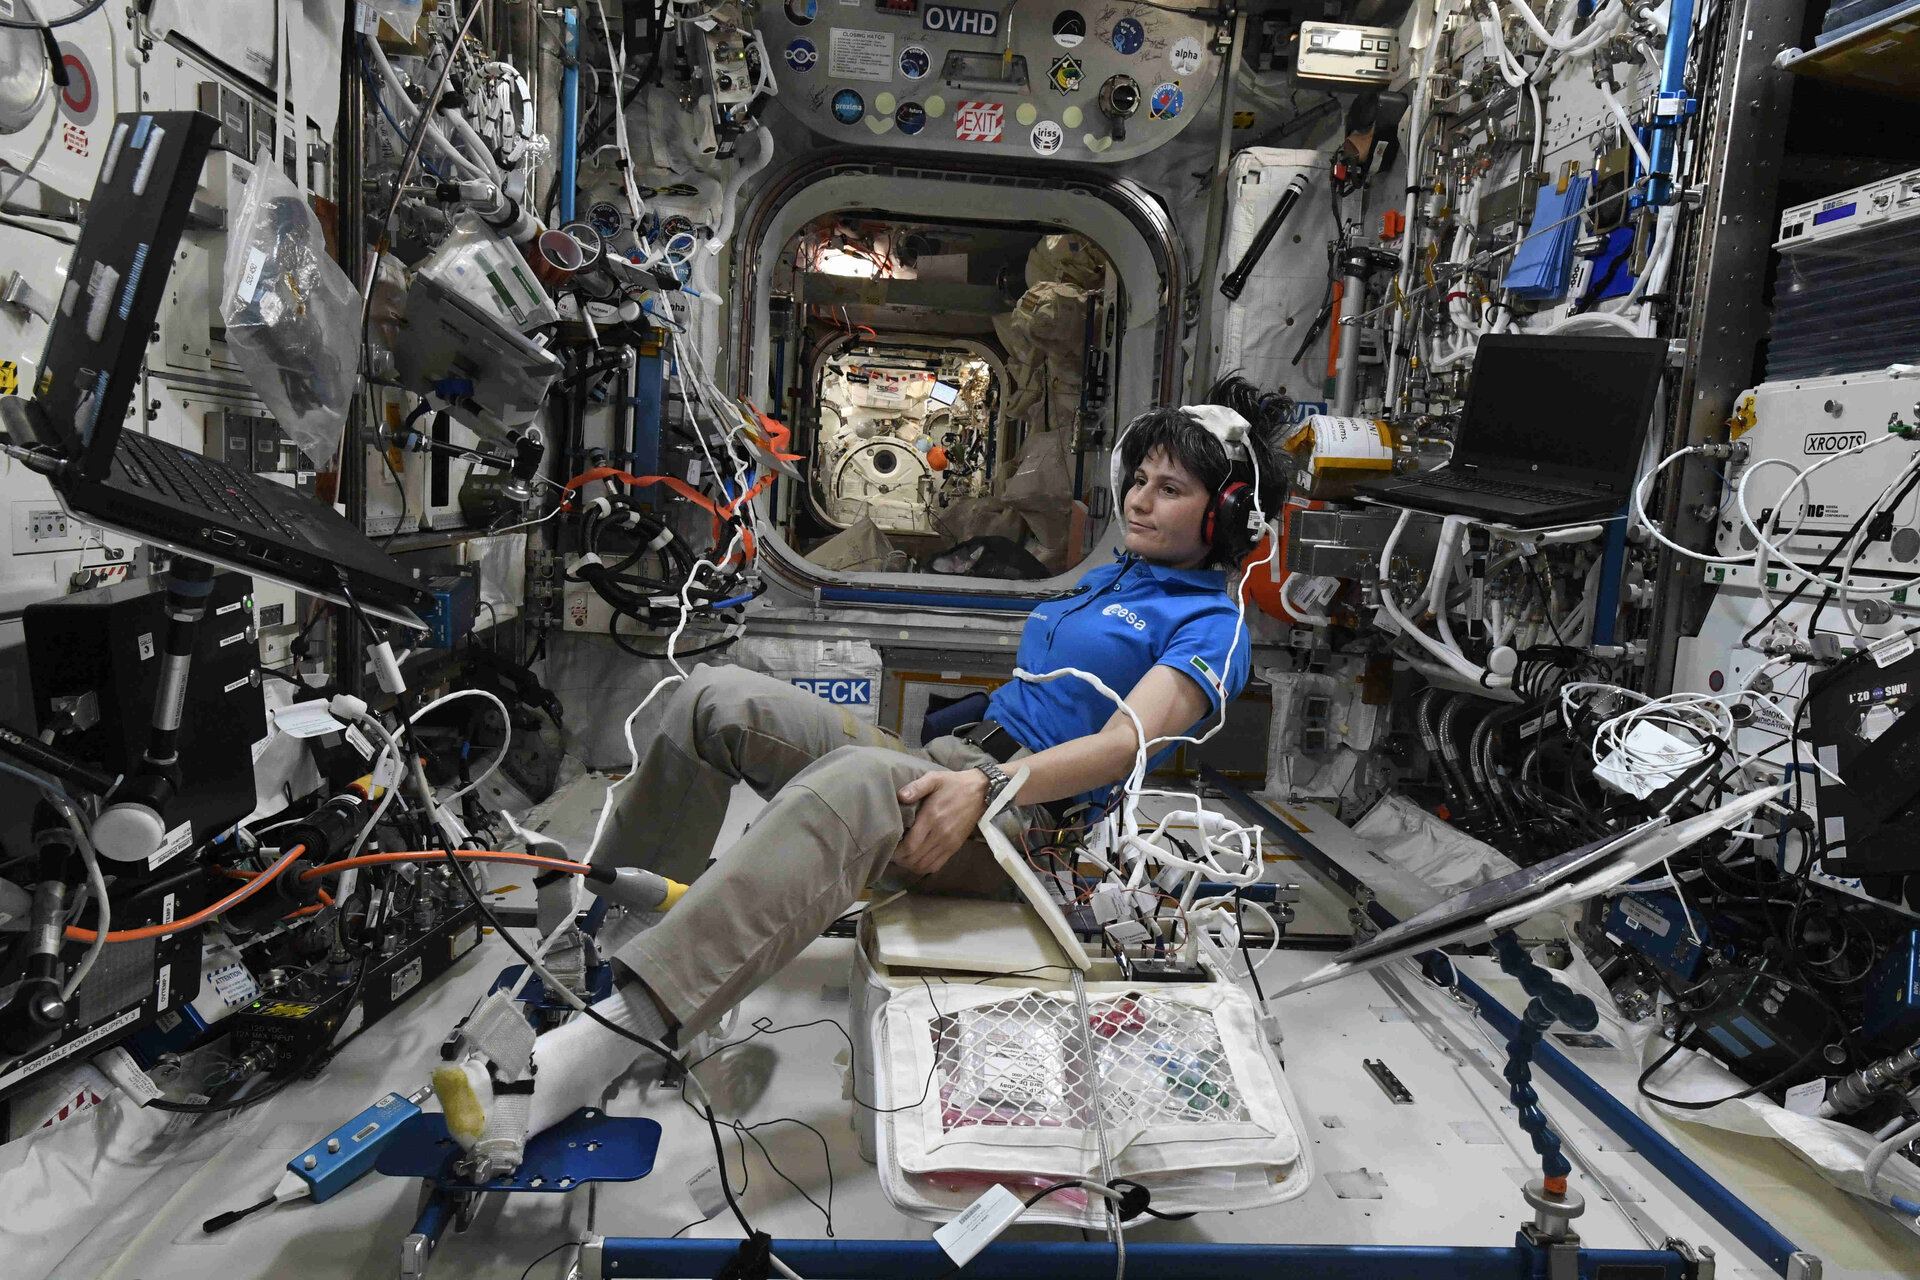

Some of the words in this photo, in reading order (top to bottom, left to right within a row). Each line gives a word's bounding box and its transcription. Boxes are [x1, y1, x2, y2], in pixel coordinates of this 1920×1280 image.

[926, 7, 997, 35] OVHD
[1175, 48, 1198, 60] alpha
[1153, 84, 1177, 99] principia
[835, 102, 862, 111] proxima
[963, 111, 996, 133] EXIT
[1037, 127, 1057, 138] iriss
[1807, 436, 1863, 451] XROOTS
[1849, 690, 1870, 704] 02.1
[1885, 683, 1908, 697] AMS
[1762, 710, 1785, 721] SMOKE
[1756, 716, 1791, 731] NDICATION
[216, 970, 242, 984] ATTENTION
[271, 1034, 295, 1042] INPUT
[23, 1048, 67, 1075] PORTABLE
[69, 1032, 99, 1051] POWER
[100, 1016, 129, 1035] SUPPLY
